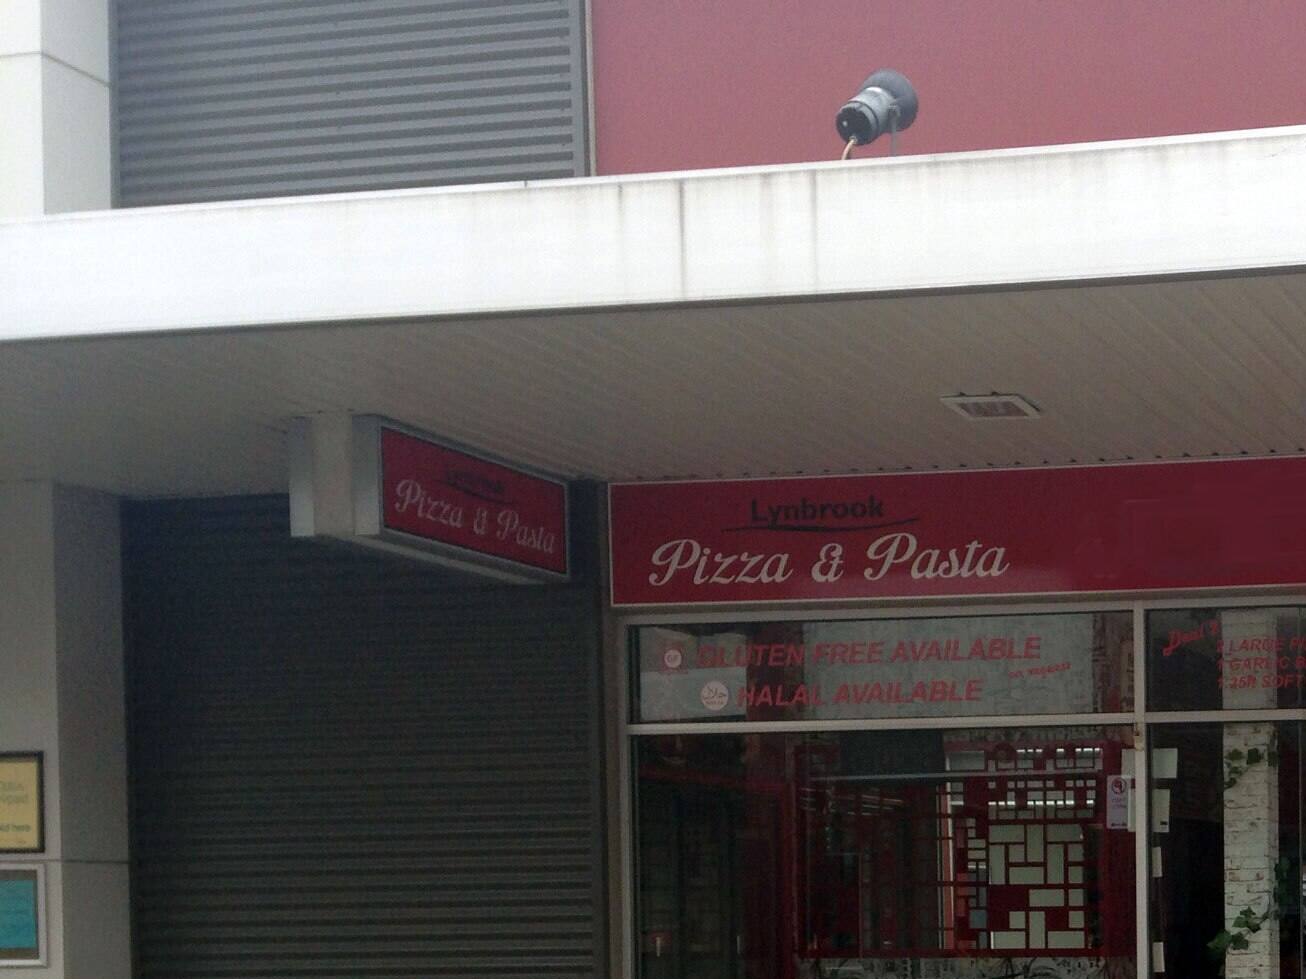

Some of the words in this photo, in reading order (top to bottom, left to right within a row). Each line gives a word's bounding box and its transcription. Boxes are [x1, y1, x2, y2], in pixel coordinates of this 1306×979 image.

[394, 478, 464, 529] Pizza
[472, 507, 489, 536] &
[496, 509, 557, 554] Pasta
[751, 496, 885, 527] Lynbrook
[648, 537, 794, 587] Pizza
[811, 542, 846, 584] &
[863, 531, 1011, 582] Pasta
[698, 642, 805, 669] GLUTEN
[812, 639, 885, 667] FREE
[889, 635, 1042, 662] AVAILABLE
[1228, 637, 1285, 656] LARGE
[1231, 657, 1289, 673] GARLIC
[736, 681, 824, 708] HALAL
[832, 678, 984, 705] AVAILABLE
[1261, 672, 1306, 690] SOFT
